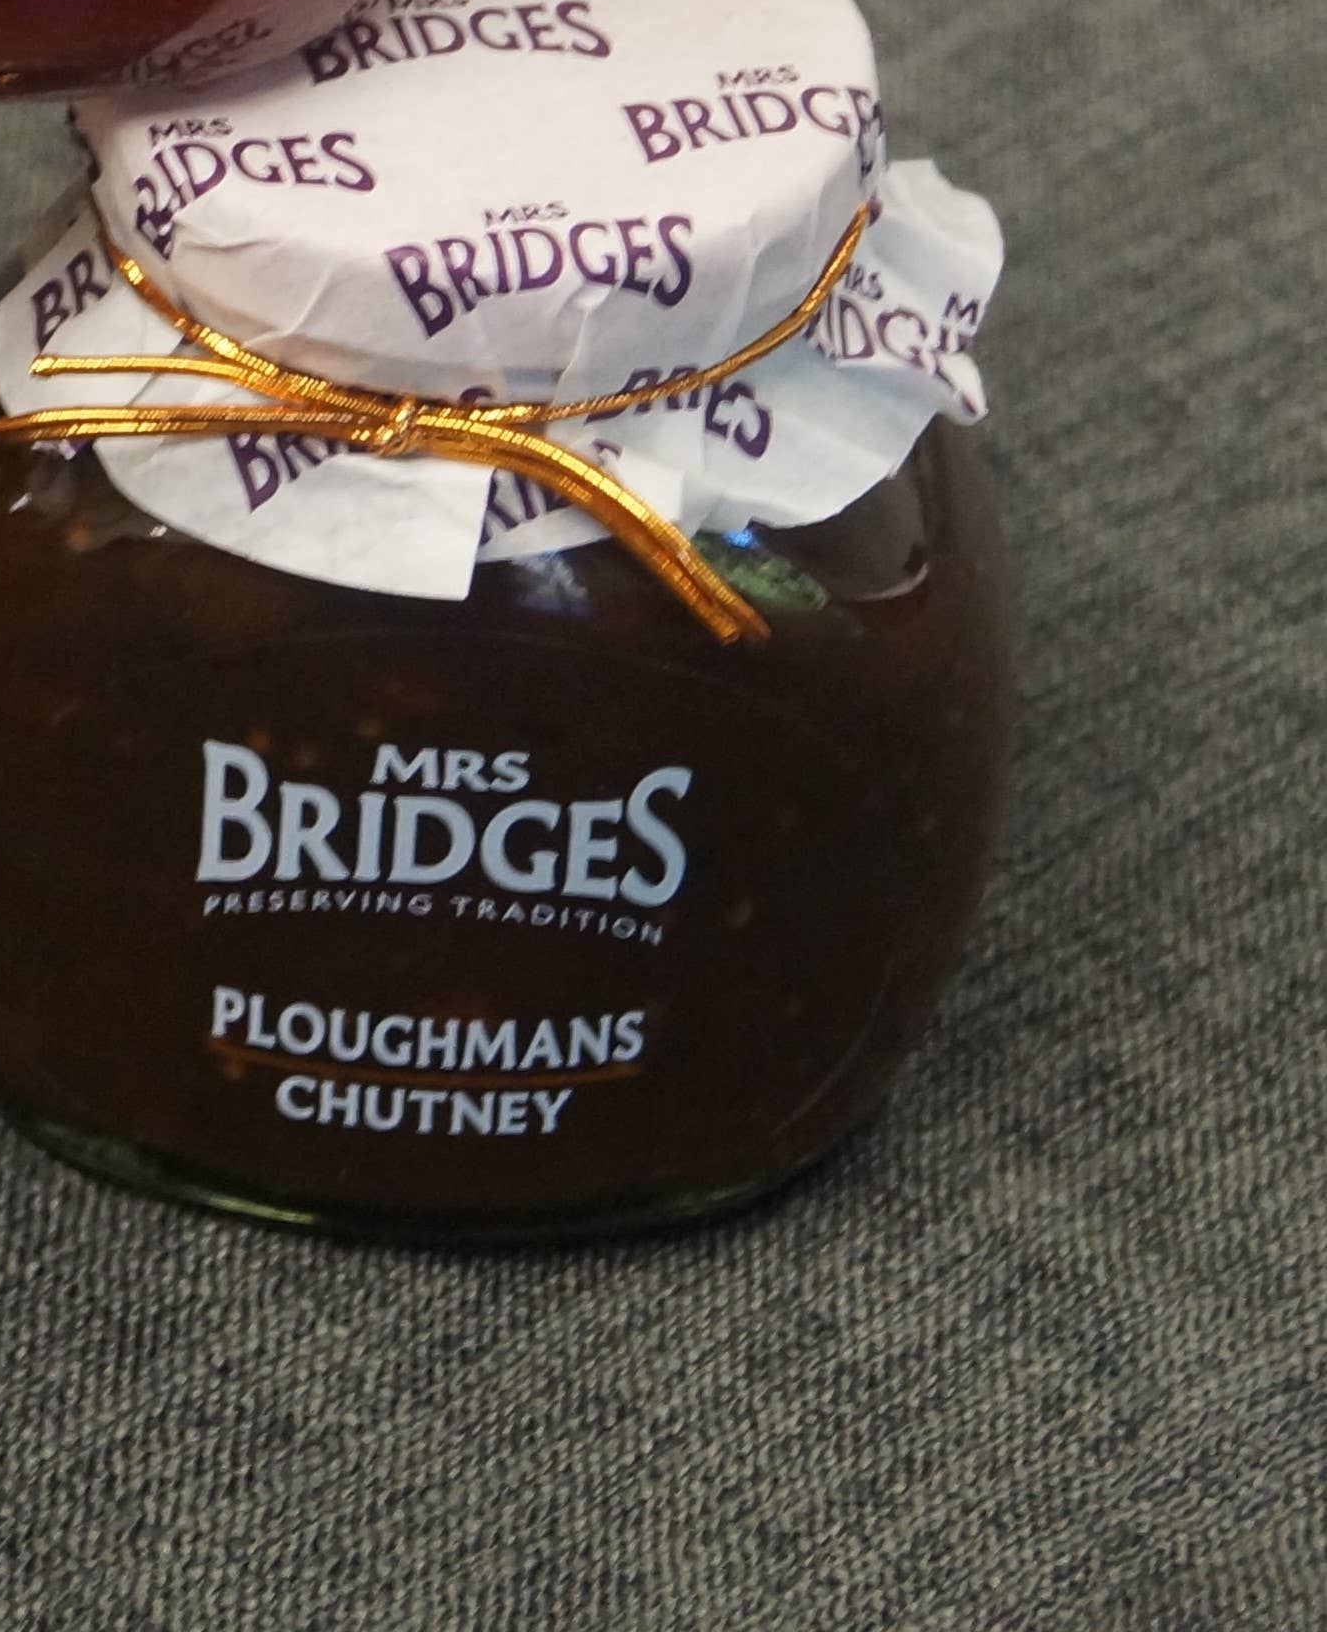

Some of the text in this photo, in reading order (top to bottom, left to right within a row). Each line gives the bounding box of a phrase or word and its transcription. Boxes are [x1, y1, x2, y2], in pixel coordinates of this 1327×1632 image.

[301, 0, 613, 88] BRIDGES
[714, 63, 800, 86] MRS
[148, 118, 234, 145] MRS
[482, 200, 569, 225] MRS
[384, 214, 694, 340] BRIDGES
[369, 742, 532, 793] MRS
[195, 738, 694, 908] BRIDGES
[202, 889, 665, 947] PRESERVING TRADITION
[211, 984, 645, 1071] PLOUGHMANS
[274, 1074, 574, 1137] CHUTNEY
